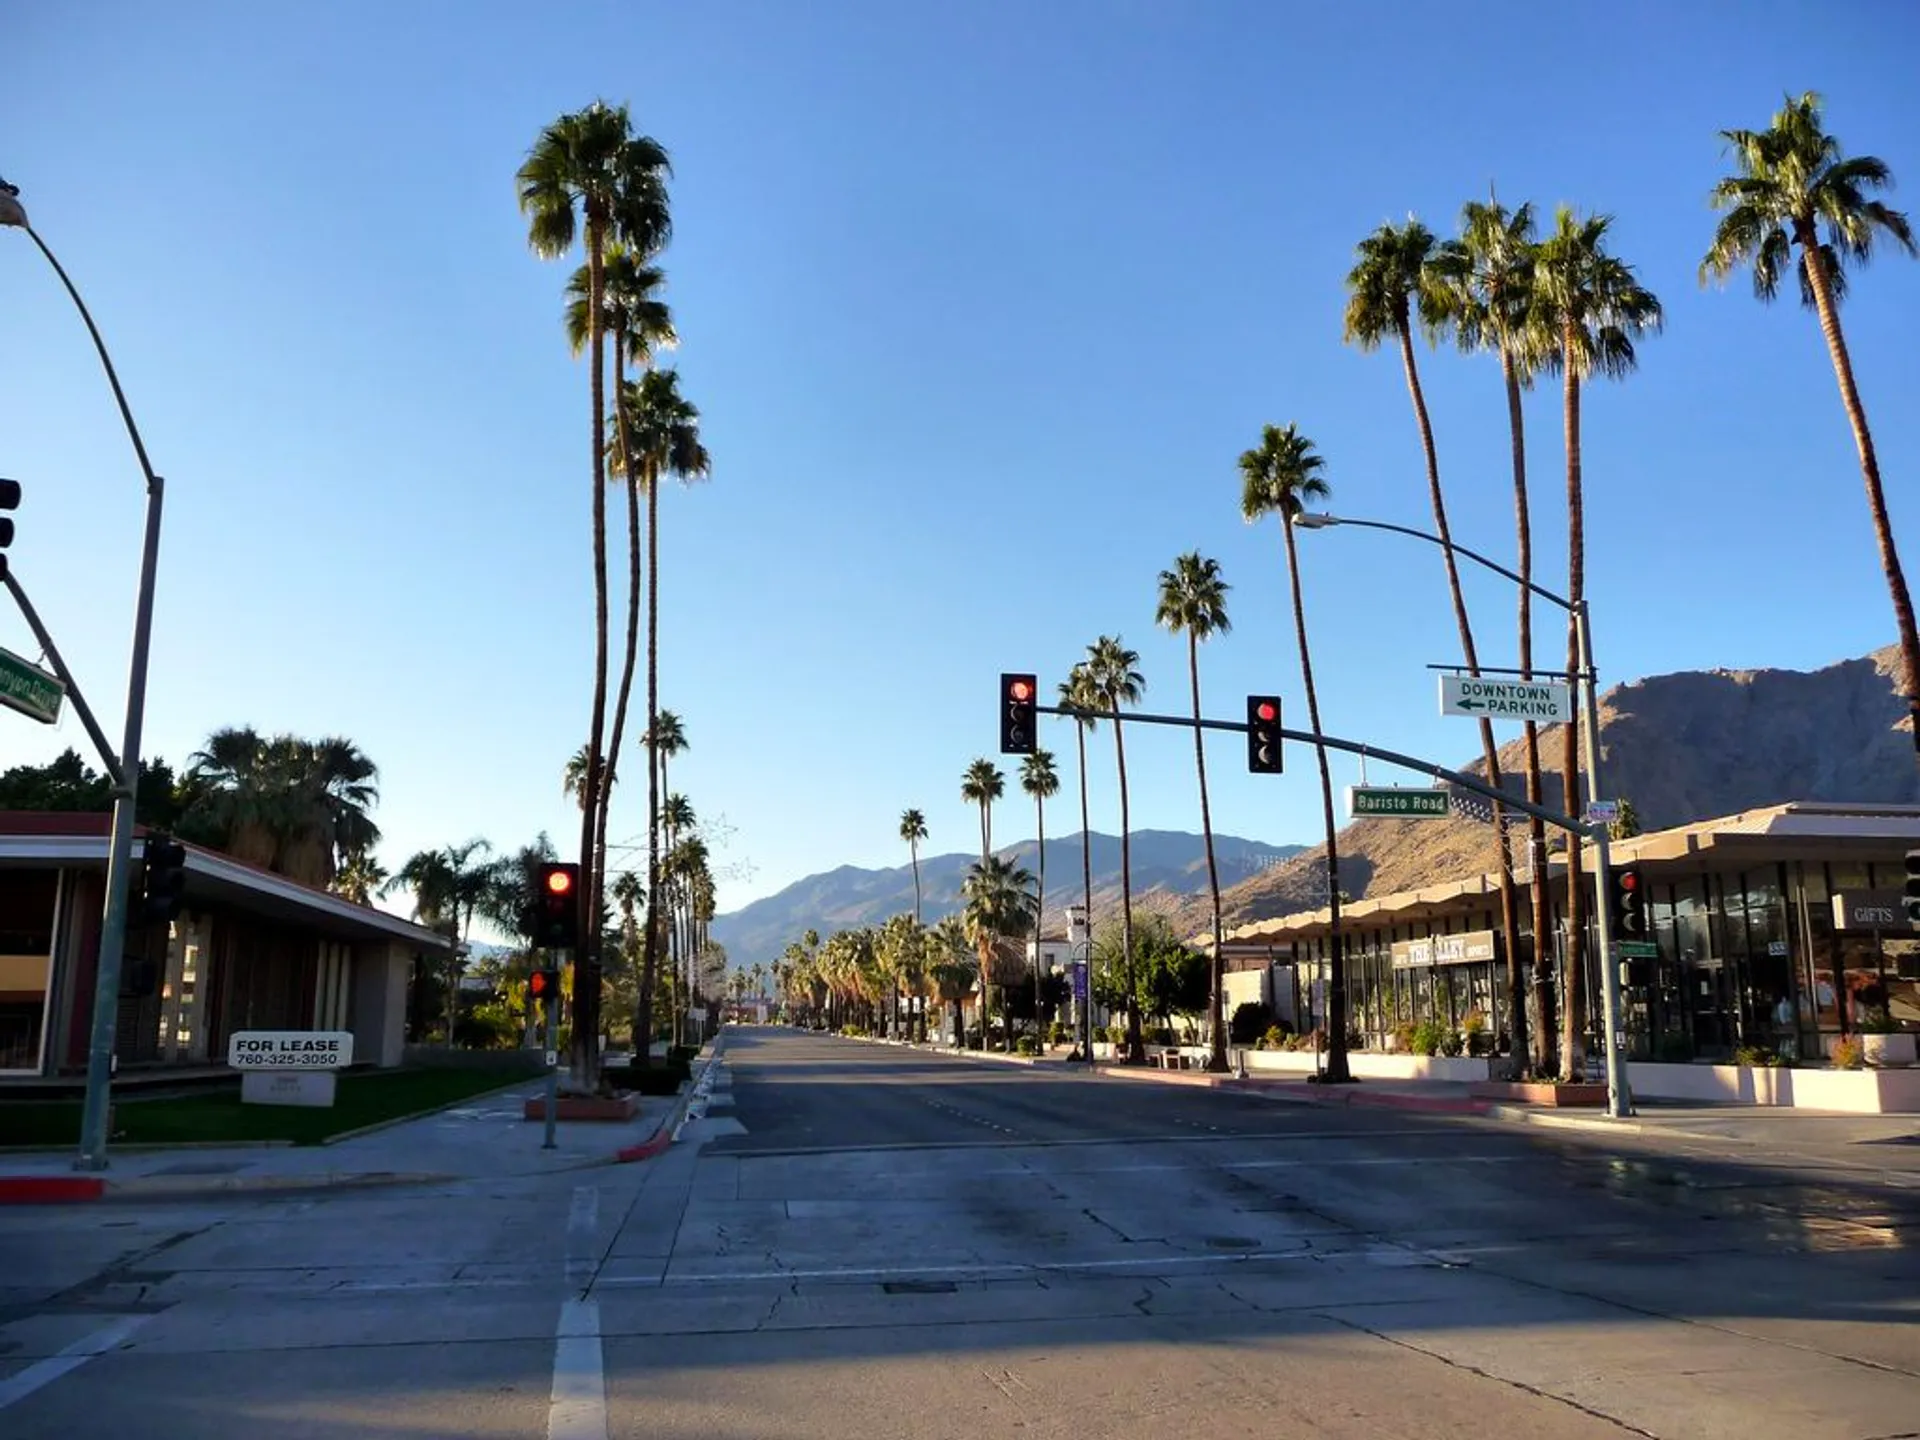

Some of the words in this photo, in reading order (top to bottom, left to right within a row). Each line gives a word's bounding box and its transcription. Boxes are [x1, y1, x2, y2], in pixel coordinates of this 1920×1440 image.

[1461, 683, 1550, 700] DOWNTOWN
[1488, 699, 1558, 715] PARKING
[1358, 795, 1407, 809] Baristo
[1413, 796, 1444, 810] Road
[1854, 907, 1893, 922] GIFTS
[236, 1040, 273, 1052] FOR
[280, 1040, 339, 1052] LEASE
[236, 1053, 338, 1065] 760-325-3050
